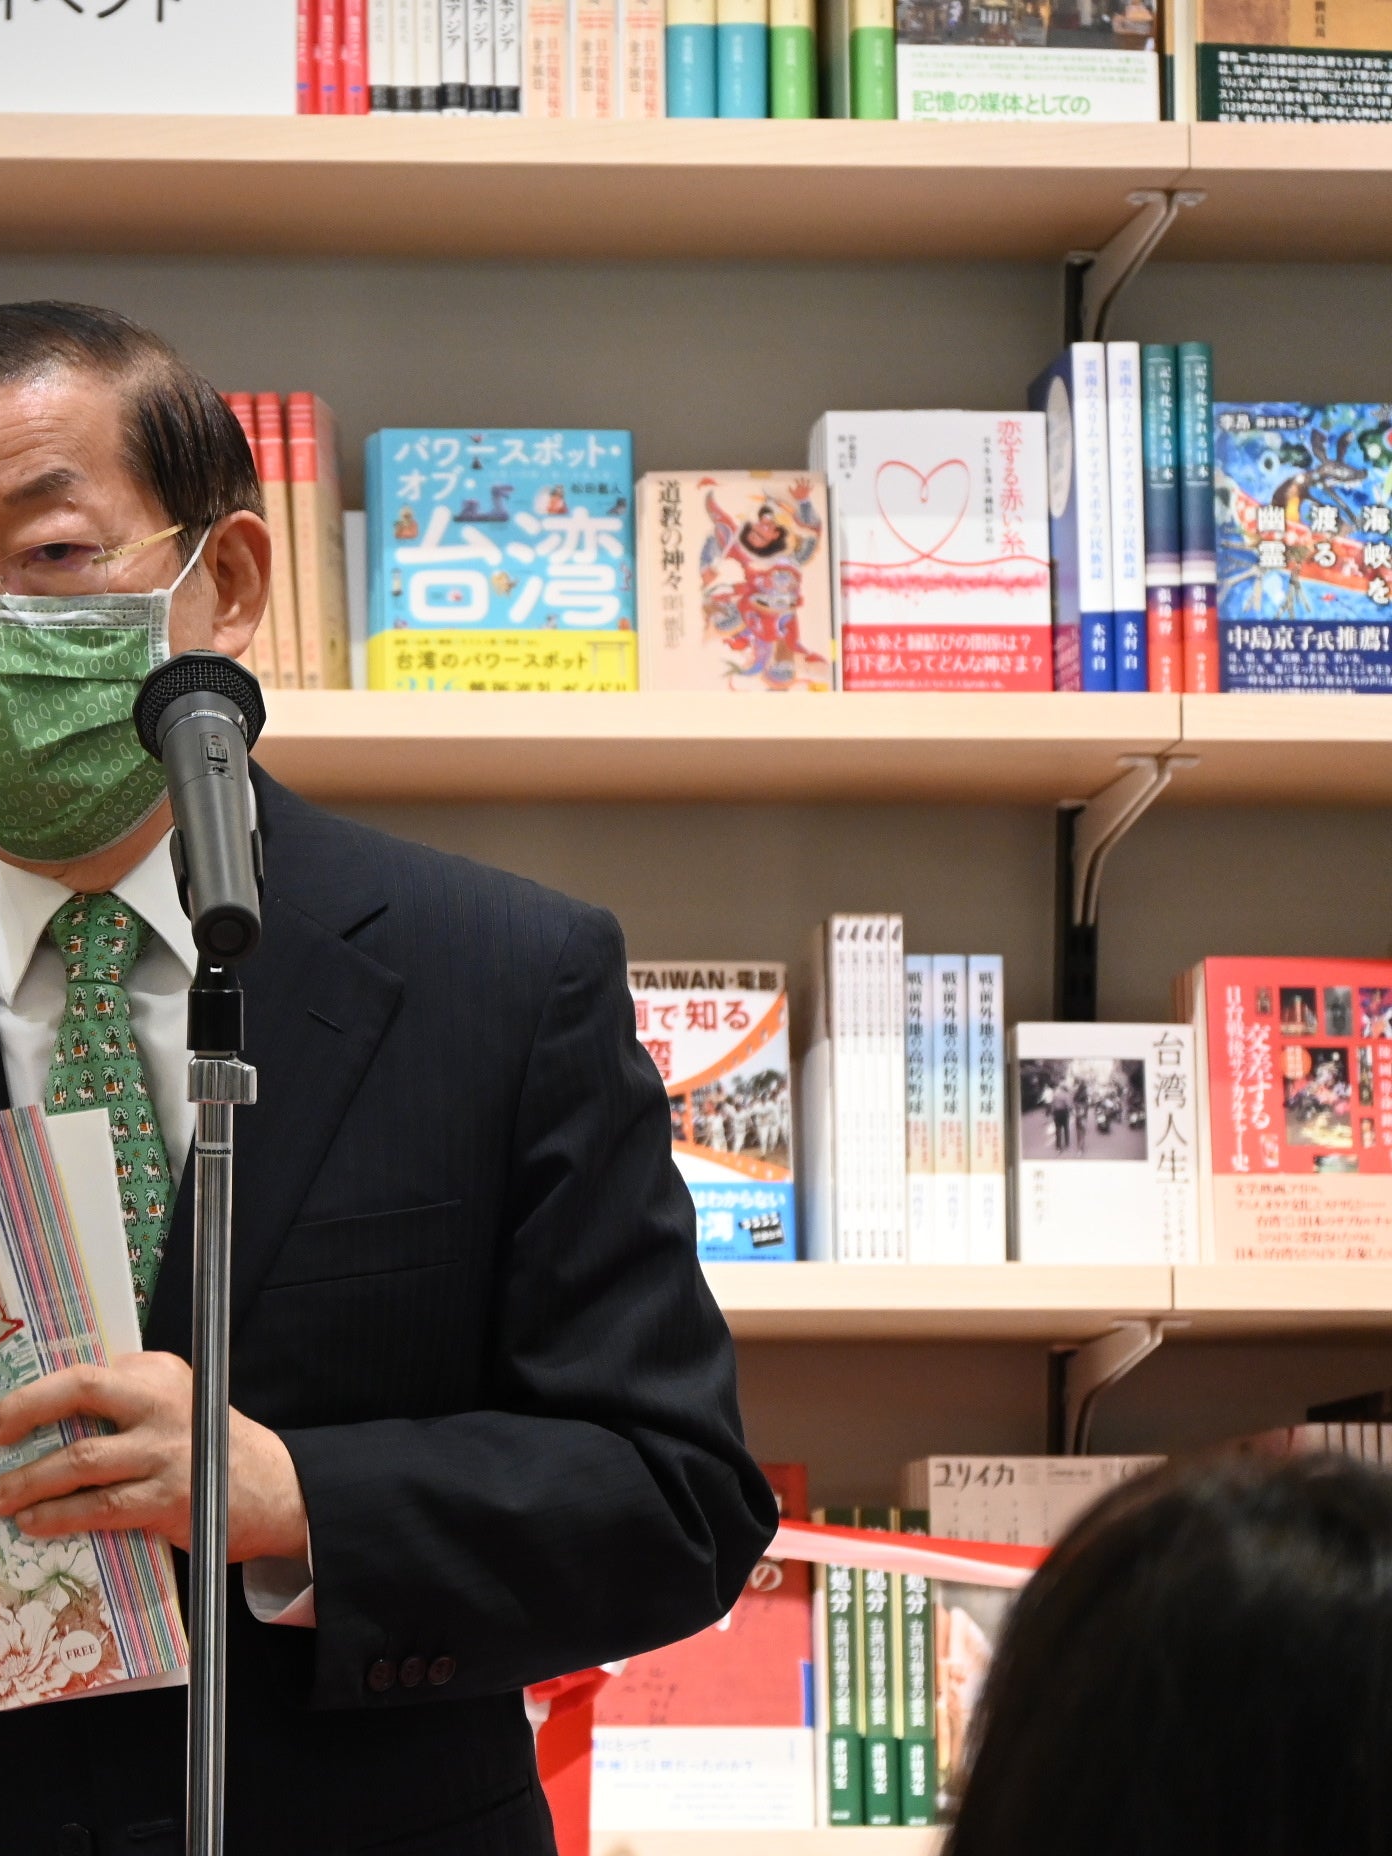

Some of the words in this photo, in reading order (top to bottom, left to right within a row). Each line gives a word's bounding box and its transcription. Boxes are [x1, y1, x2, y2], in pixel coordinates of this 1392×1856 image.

[997, 421, 1026, 555] 恋する赤い糸
[395, 505, 625, 627] 台湾
[658, 479, 685, 591] 道教の神々
[1257, 504, 1287, 568] 幽霊
[1311, 504, 1339, 568] 渡る
[1363, 504, 1391, 605] 海峡を
[396, 651, 589, 670] 台湾のパワースポット
[1227, 625, 1390, 652] 中島京子氏推薦!
[1152, 1031, 1190, 1186] 台湾人生
[933, 1463, 1015, 1490] ユリイカ
[66, 1643, 97, 1661] FREE
